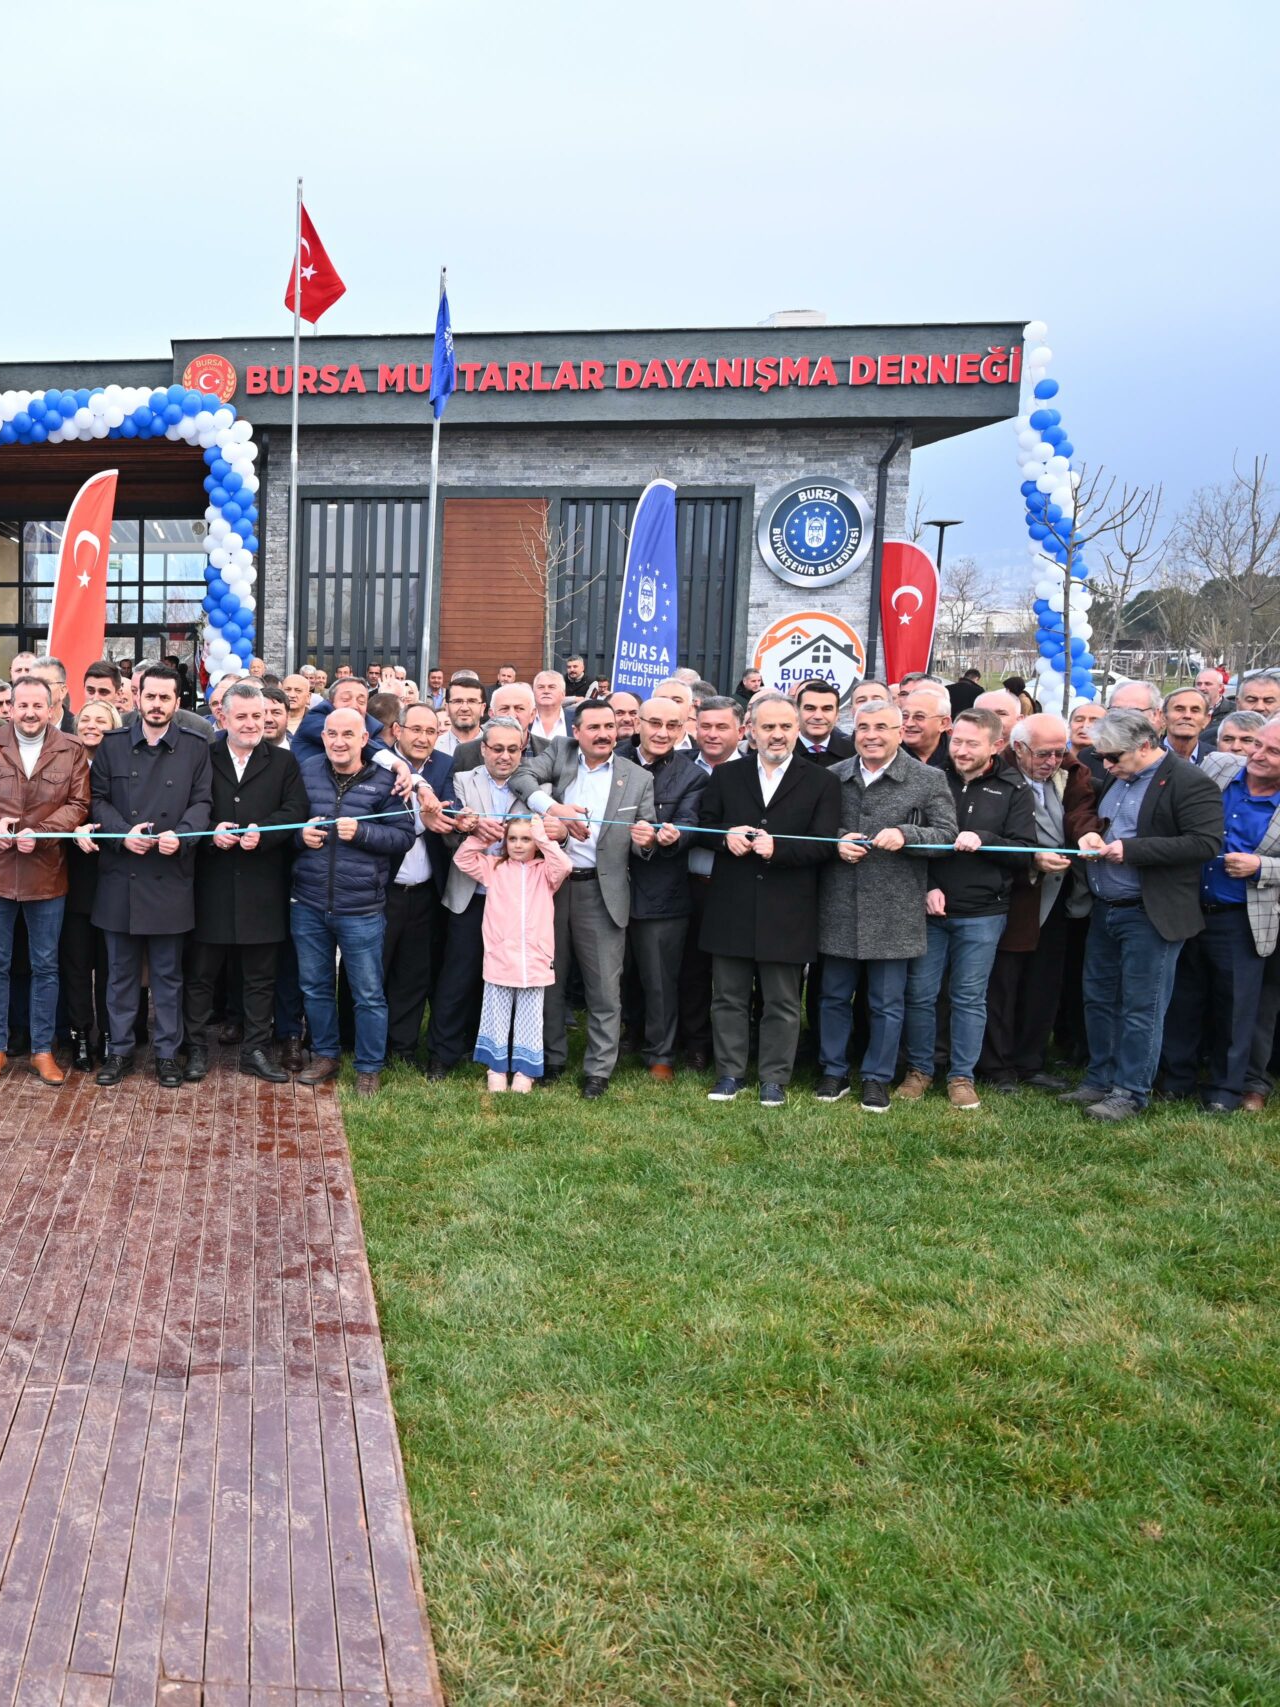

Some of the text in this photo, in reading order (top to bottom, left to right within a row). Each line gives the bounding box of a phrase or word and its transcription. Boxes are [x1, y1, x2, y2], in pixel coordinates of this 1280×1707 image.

[195, 359, 223, 368] BURSA
[246, 346, 1021, 395] BURSA MUTARLAR DAYANIŞMA DERNEĞİ
[798, 489, 839, 503] BURSA
[772, 527, 860, 575] BÜYÜKŞEHİR BELEDİYESİ
[621, 640, 670, 663] BURSA
[620, 658, 670, 676] BÜYÜKŞEHİR
[781, 668, 836, 681] BURSA
[618, 673, 660, 688] BELEDİYE
